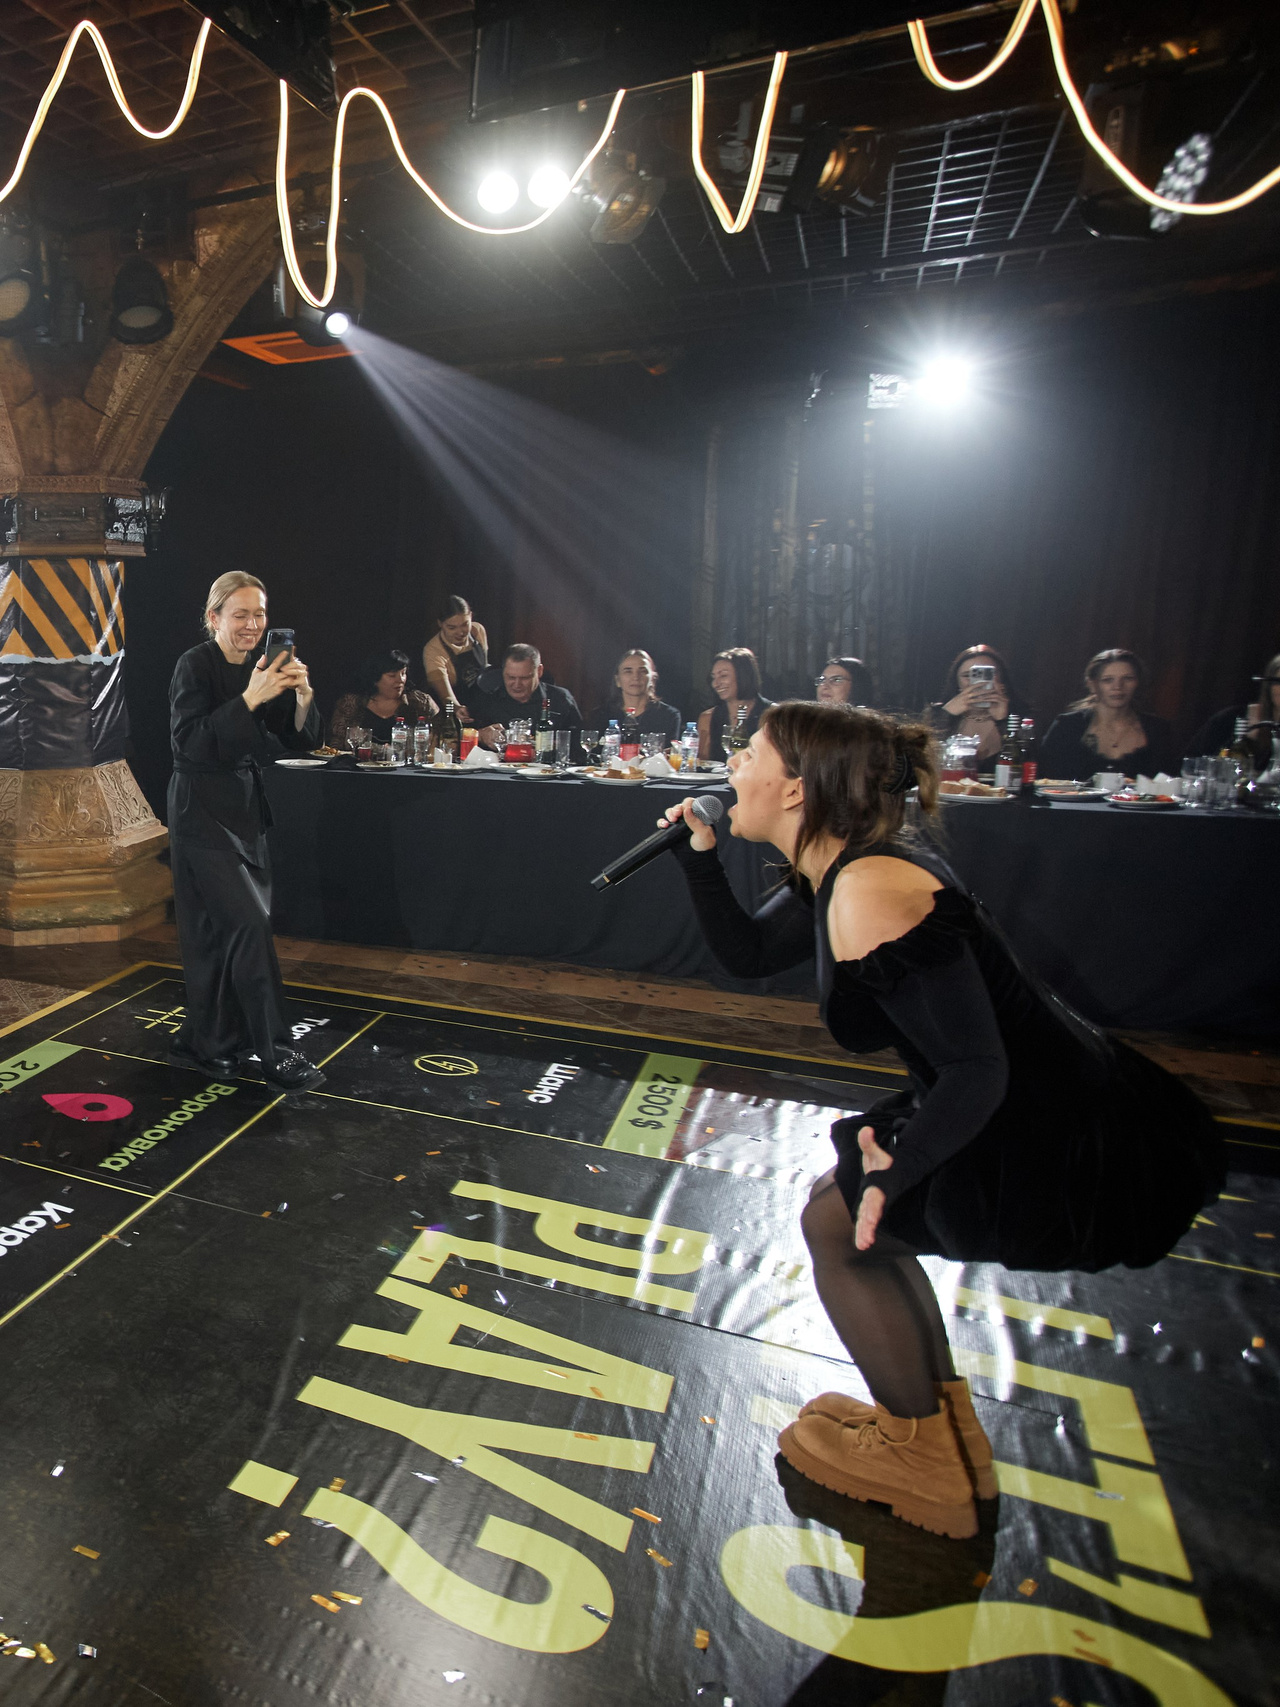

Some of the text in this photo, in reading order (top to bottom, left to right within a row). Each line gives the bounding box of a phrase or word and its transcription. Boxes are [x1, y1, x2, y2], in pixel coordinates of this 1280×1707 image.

[527, 1062, 580, 1104] Шанс
[628, 1073, 682, 1130] 2500 $
[98, 1082, 239, 1171] Вороновка
[227, 1180, 713, 1654] PLAY?
